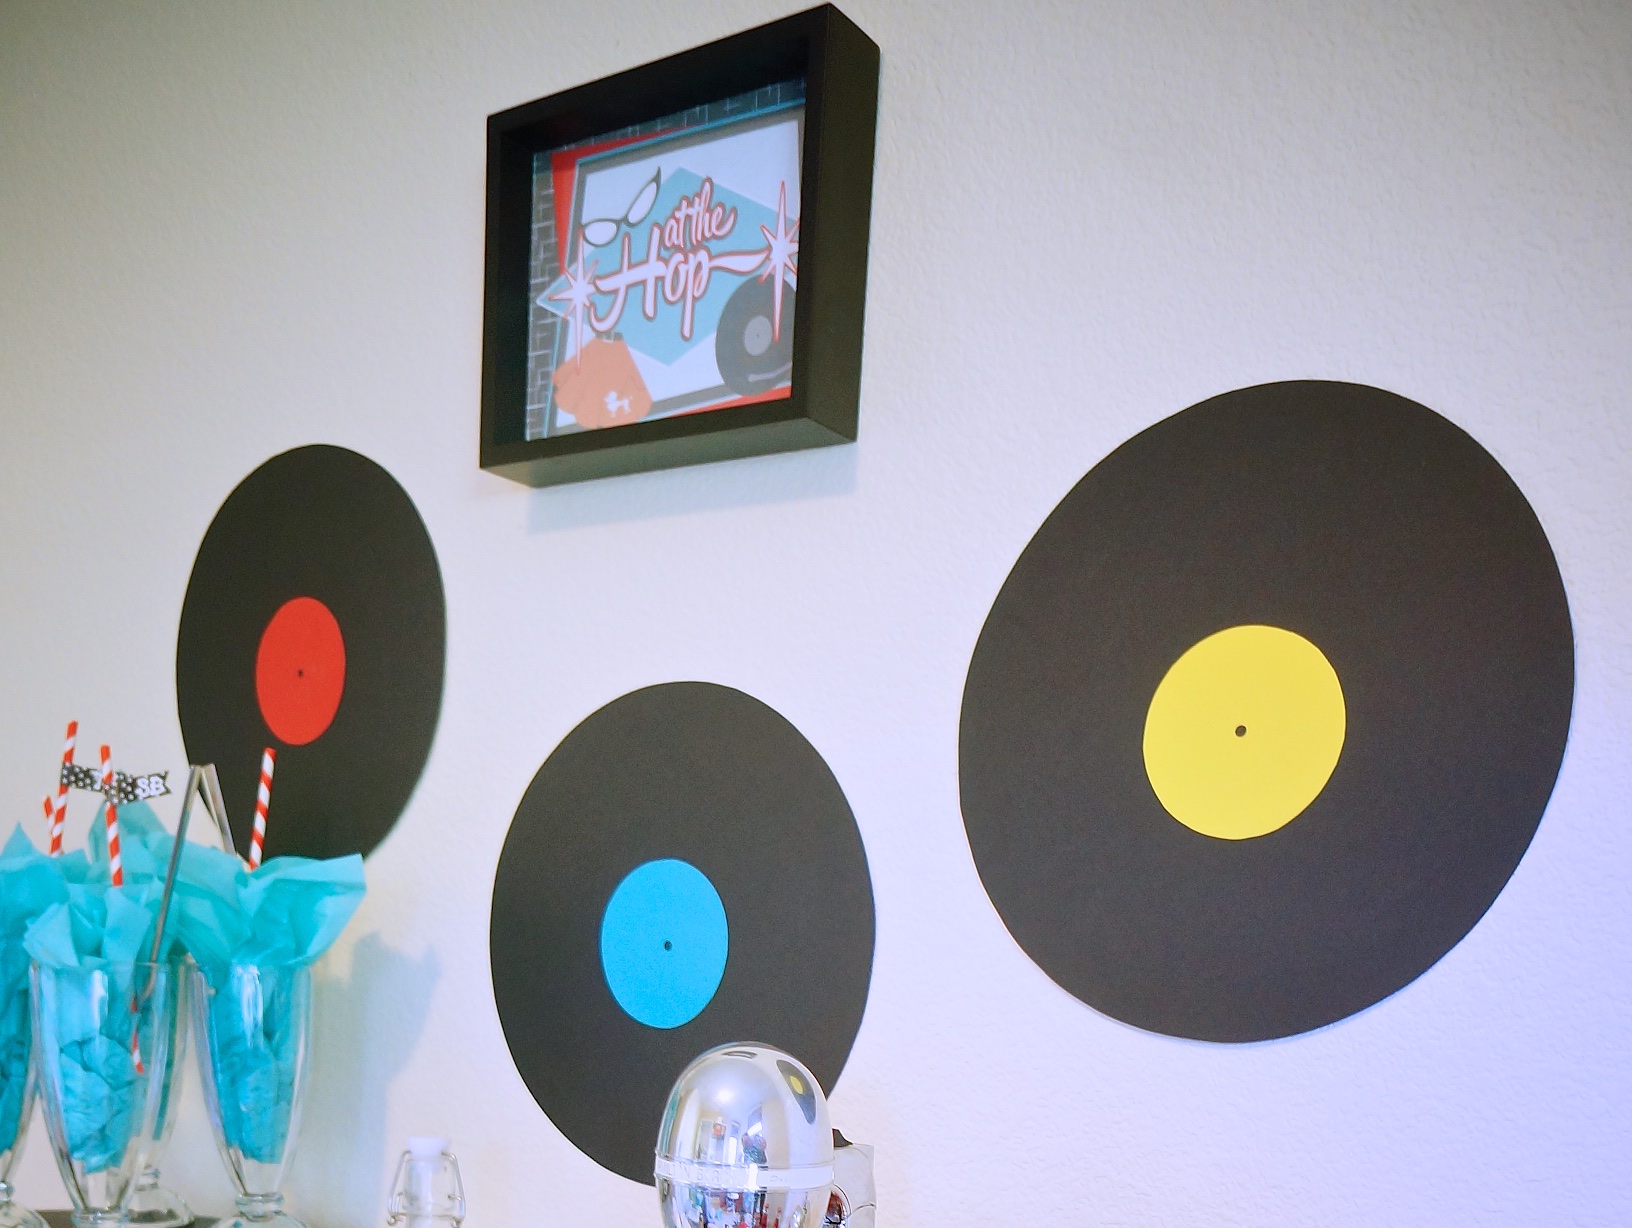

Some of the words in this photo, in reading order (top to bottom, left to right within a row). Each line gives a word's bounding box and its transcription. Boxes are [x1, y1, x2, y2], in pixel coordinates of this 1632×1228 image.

[663, 196, 691, 249] at
[689, 176, 737, 247] the
[588, 222, 770, 341] Hop
